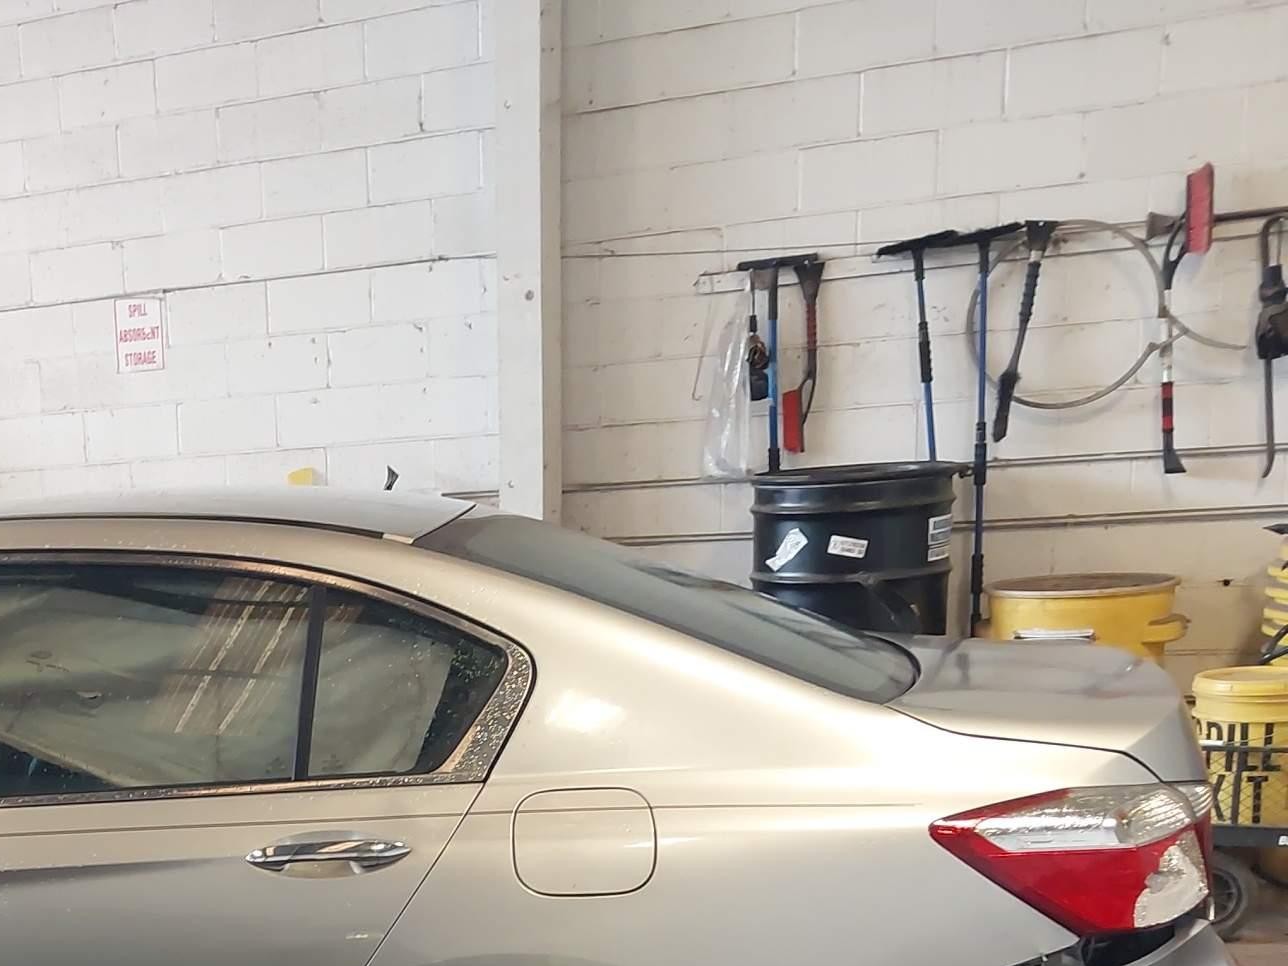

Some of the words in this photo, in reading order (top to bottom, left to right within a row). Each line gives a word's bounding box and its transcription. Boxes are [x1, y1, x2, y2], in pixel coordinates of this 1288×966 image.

[125, 350, 157, 366] STORAGE
[1193, 718, 1281, 772] PILL
[1213, 773, 1269, 824] KT
